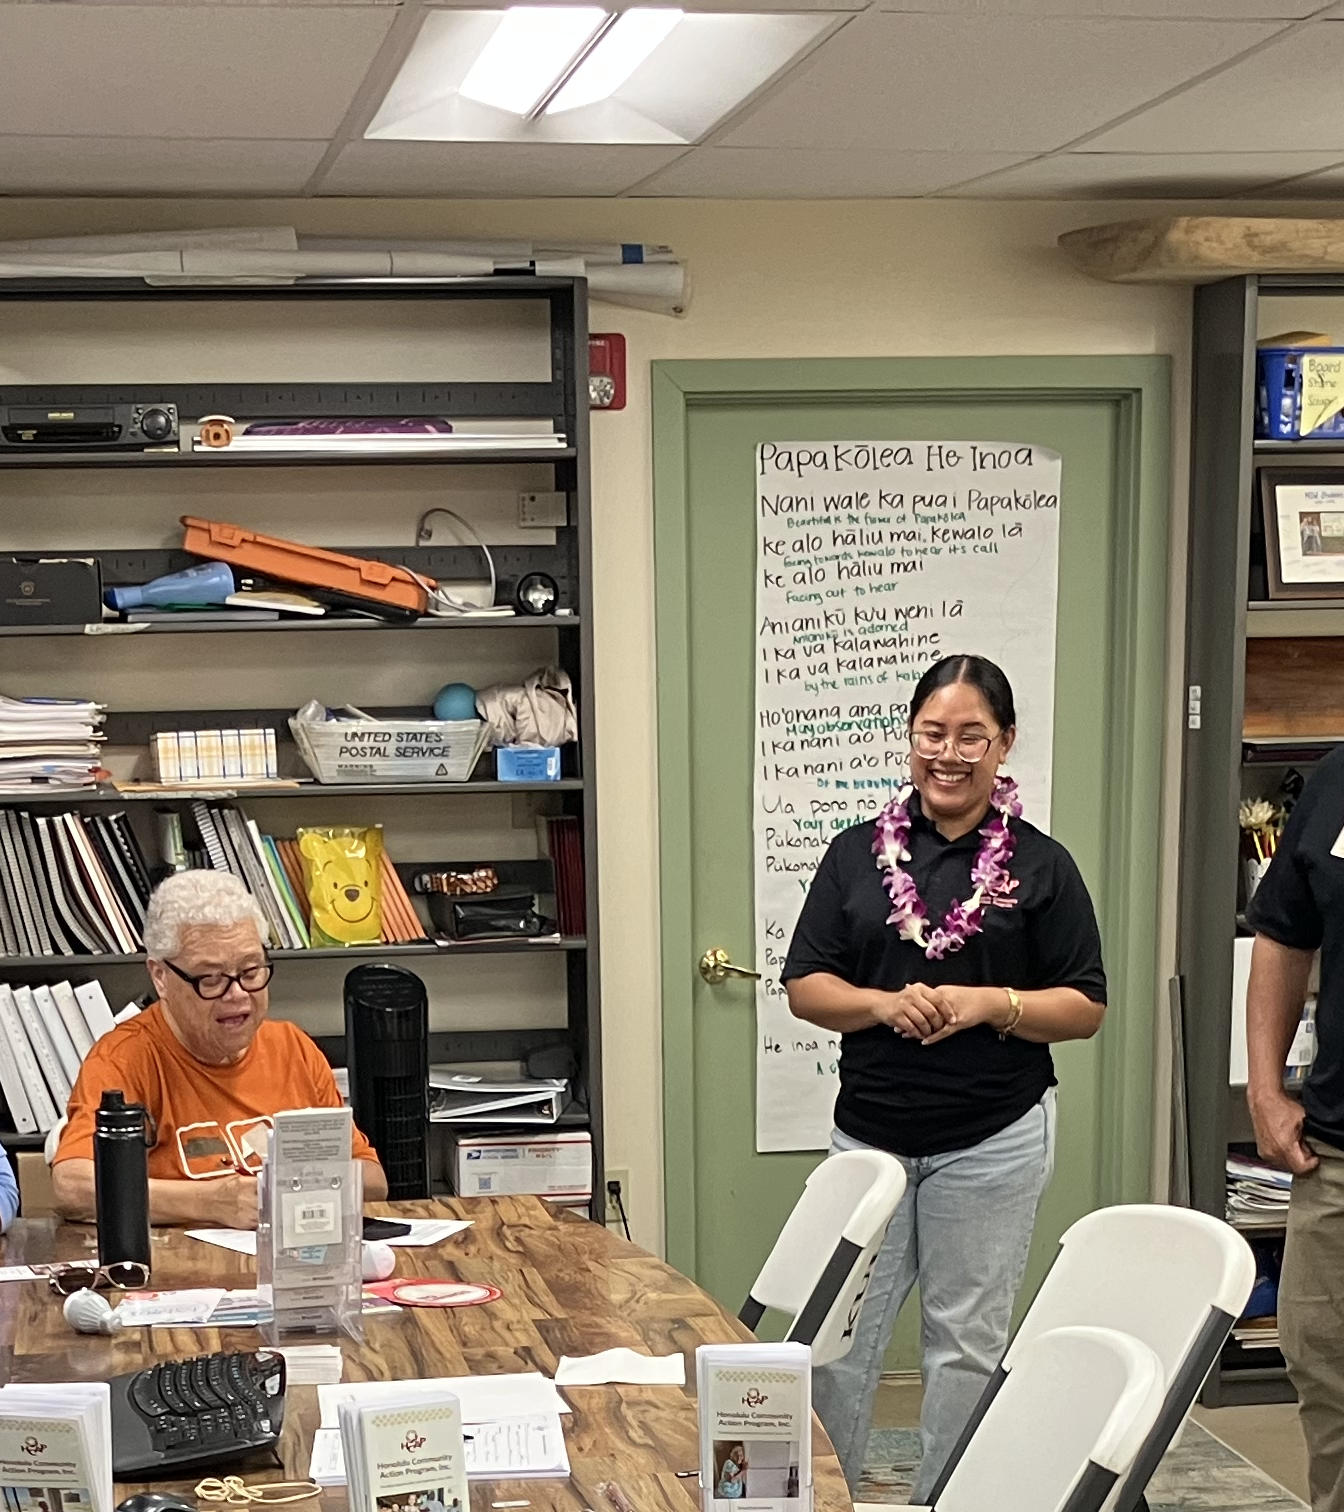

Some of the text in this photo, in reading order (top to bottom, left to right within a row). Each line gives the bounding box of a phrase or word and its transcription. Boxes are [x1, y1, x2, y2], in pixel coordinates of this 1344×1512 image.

[926, 444, 964, 472] He
[970, 446, 1034, 472] Inoa
[761, 493, 815, 518] Nani
[823, 491, 871, 513] wale
[792, 533, 823, 553] alo
[1002, 522, 1023, 538] lā
[972, 542, 998, 554] call
[792, 567, 826, 585] alo
[890, 558, 923, 575] mai
[825, 588, 846, 599] out
[855, 585, 867, 597] to
[869, 580, 899, 593] hear
[942, 600, 964, 618] lā
[849, 703, 882, 718] ana
[344, 731, 444, 743] UNITED STATES
[800, 734, 840, 750] nani
[339, 746, 451, 758] POSTAL SERVICE
[803, 758, 843, 775] nani
[761, 794, 877, 819] Ua pono nō
[763, 1034, 818, 1053] He inoa
